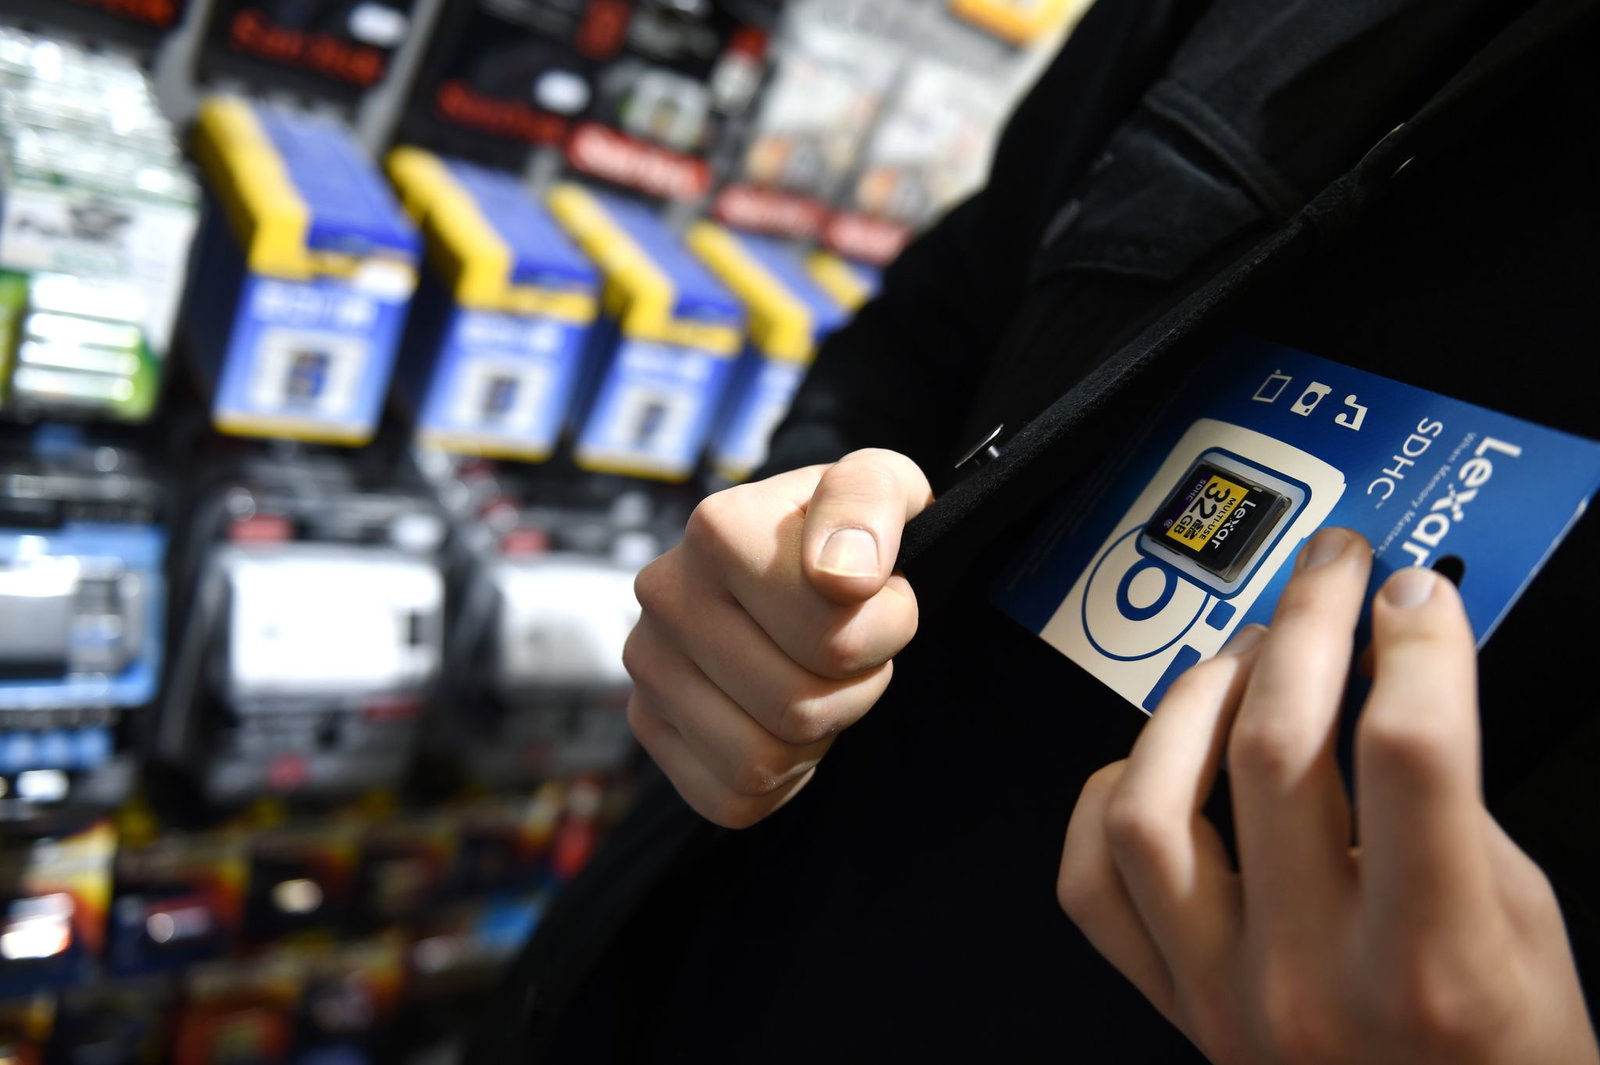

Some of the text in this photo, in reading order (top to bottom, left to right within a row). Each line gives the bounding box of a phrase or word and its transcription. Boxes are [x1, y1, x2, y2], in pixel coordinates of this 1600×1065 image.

[1447, 432, 1476, 463] When
[1186, 479, 1206, 501] SDHC
[1190, 482, 1231, 520] 32
[1402, 437, 1522, 567] Lexar
[1412, 464, 1452, 508] Memory
[1174, 514, 1193, 535] GB
[1200, 497, 1237, 540] MULTI-USE
[1211, 499, 1257, 549] Lexar
